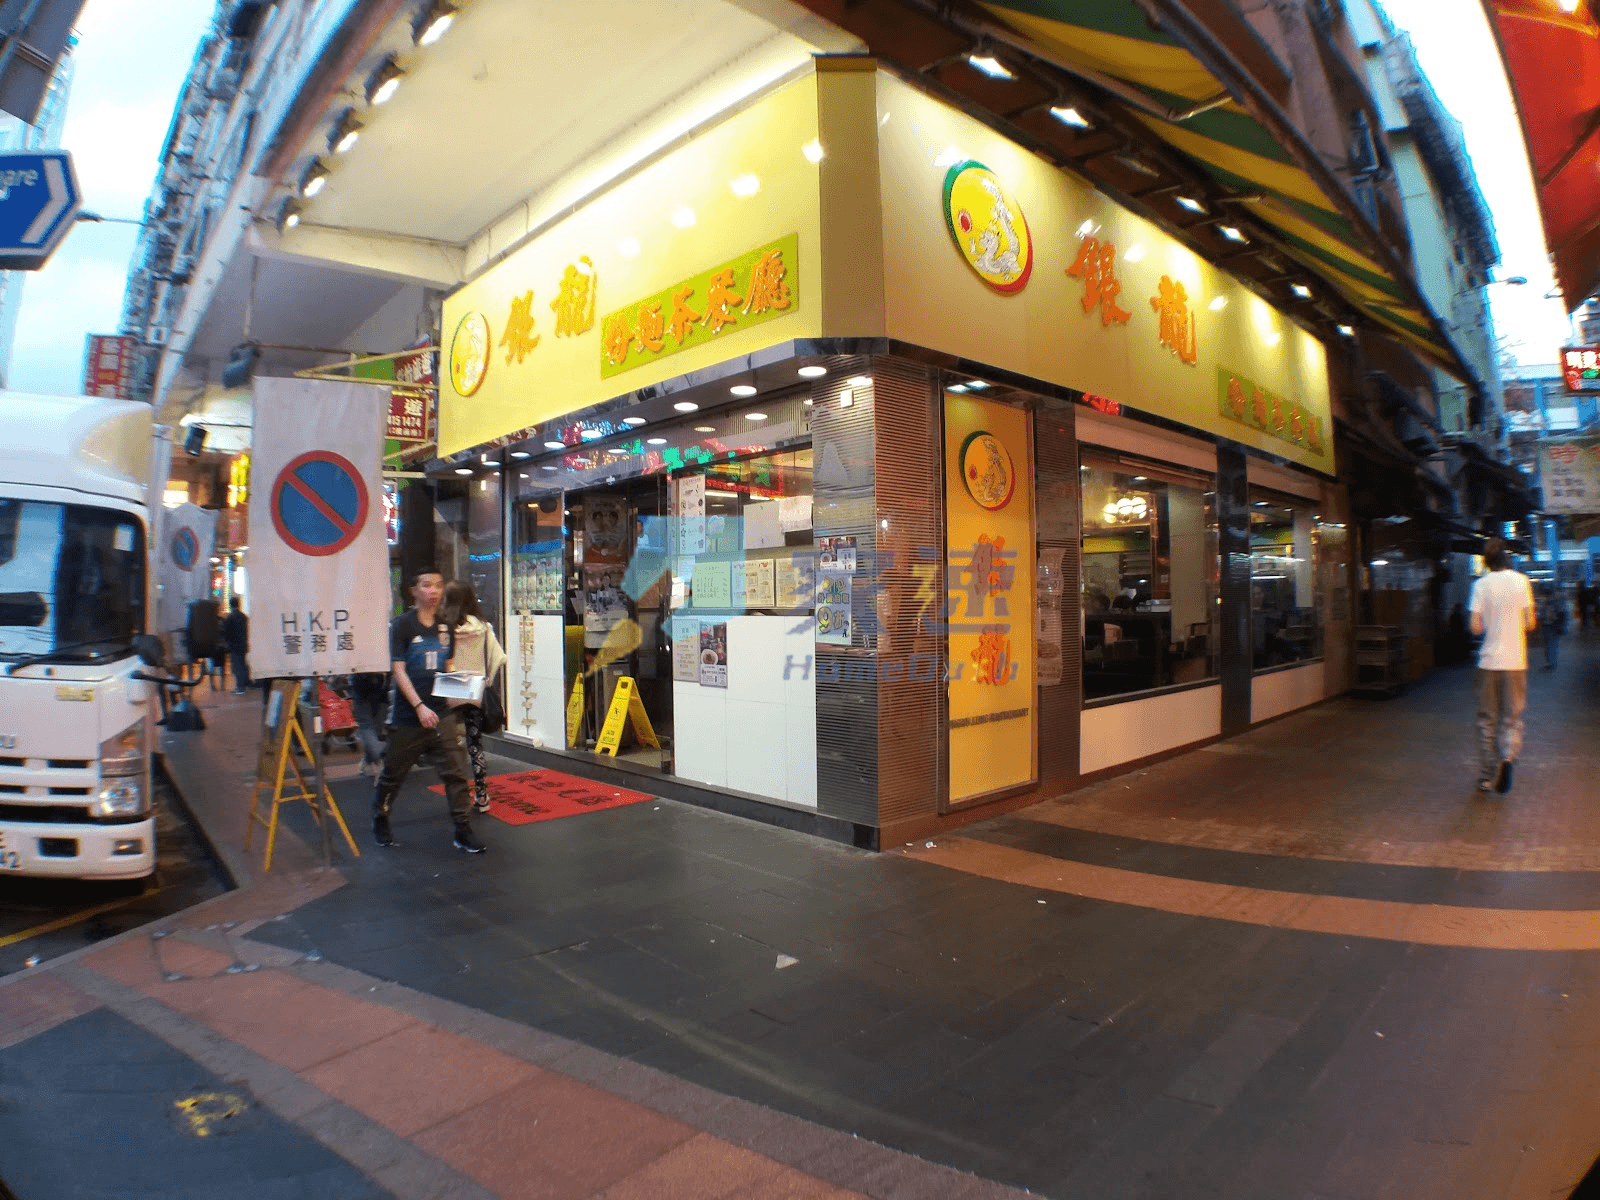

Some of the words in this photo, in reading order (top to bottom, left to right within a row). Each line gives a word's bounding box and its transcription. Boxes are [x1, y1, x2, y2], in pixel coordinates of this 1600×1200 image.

[281, 609, 355, 633] H.K.P.
[282, 631, 354, 655] 警務處
